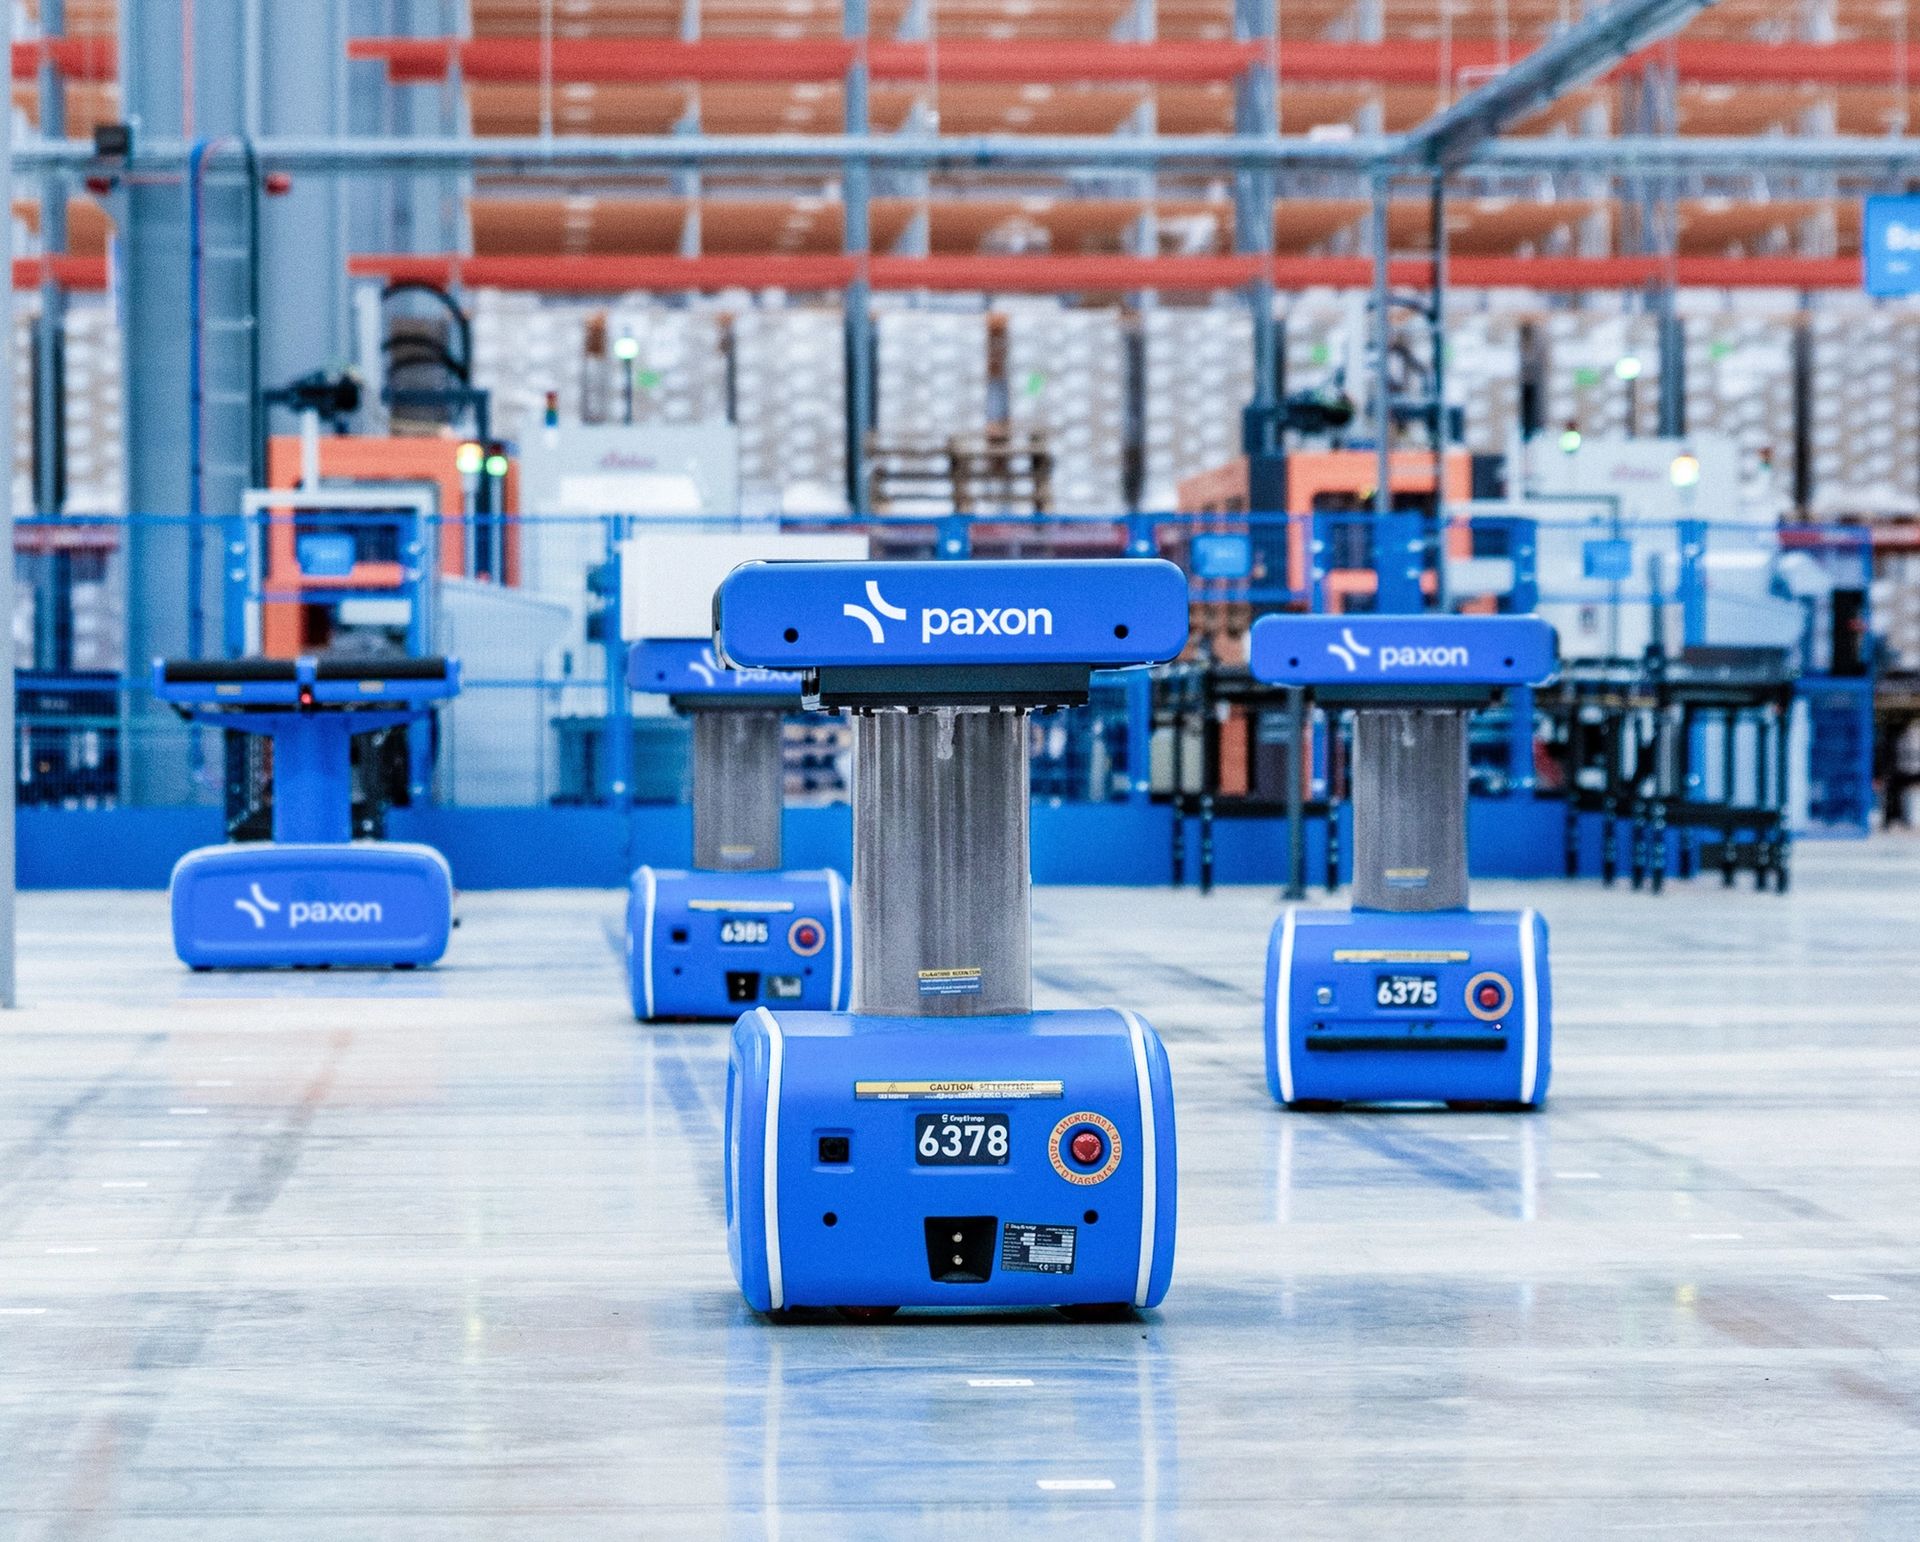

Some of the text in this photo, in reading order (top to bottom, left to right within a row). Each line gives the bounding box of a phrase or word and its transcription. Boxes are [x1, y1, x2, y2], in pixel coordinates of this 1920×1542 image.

[921, 607, 1053, 644] paxon
[1379, 646, 1469, 672] paxon
[735, 670, 803, 687] paxo
[289, 901, 382, 928] paxon
[1377, 981, 1438, 1005] 6375
[929, 1083, 974, 1092] CAUTION
[918, 1124, 1009, 1157] 6378
